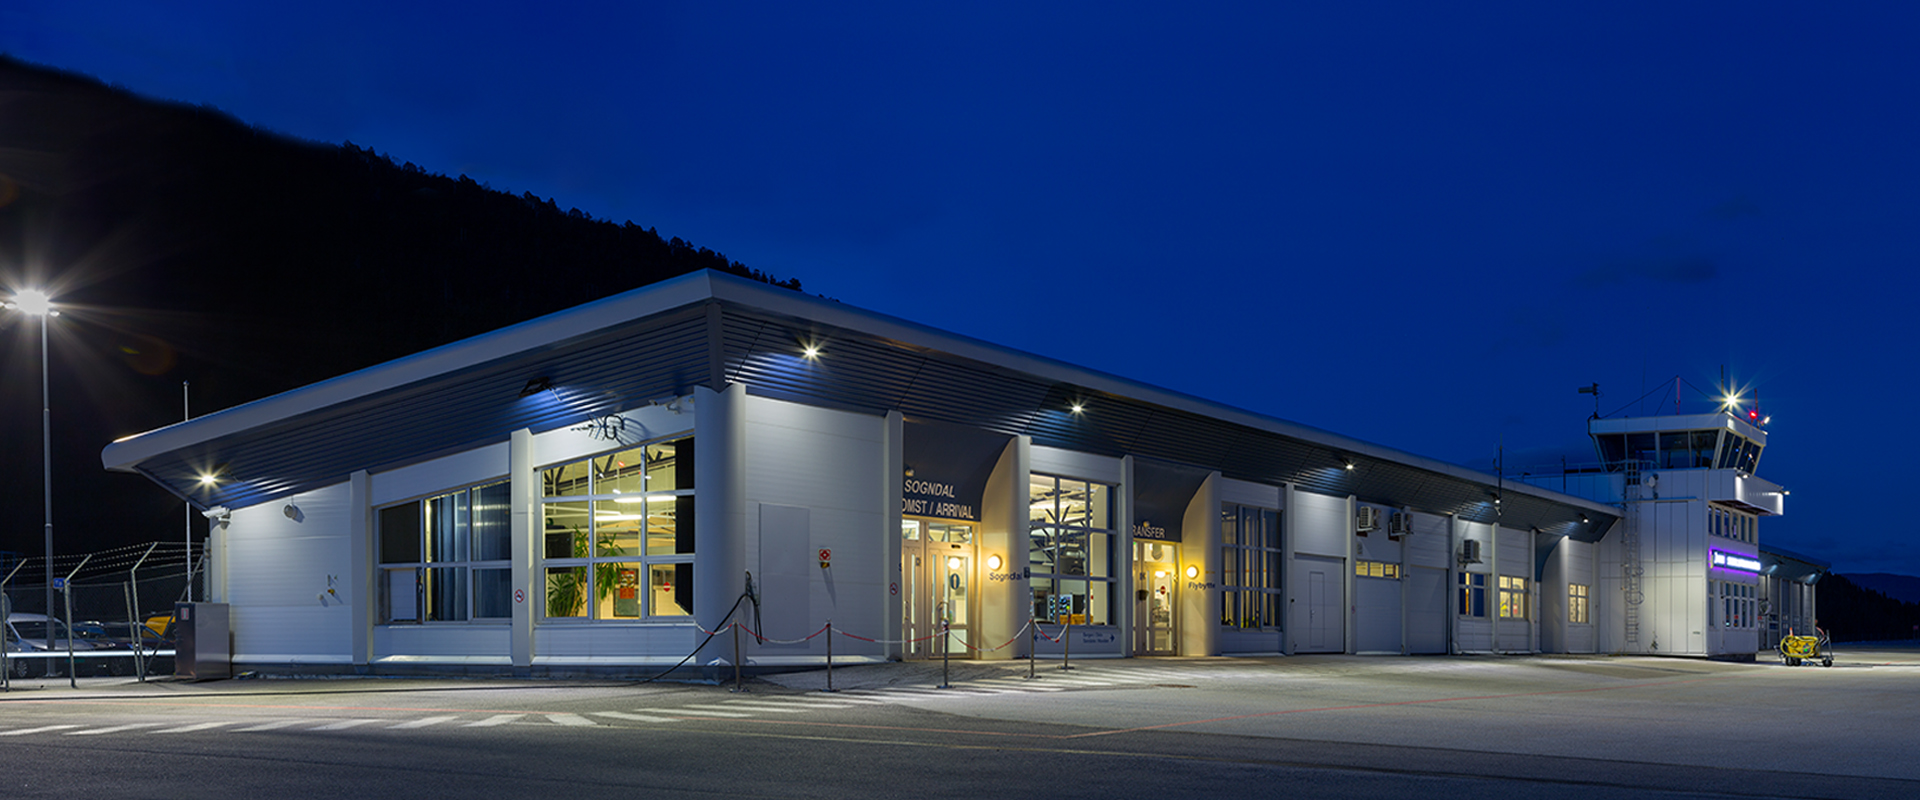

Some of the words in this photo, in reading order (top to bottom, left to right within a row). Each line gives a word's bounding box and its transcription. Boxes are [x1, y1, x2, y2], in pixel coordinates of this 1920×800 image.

[904, 479, 955, 498] SOGNDAL
[935, 502, 974, 519] ARRIVAL
[989, 571, 1023, 582] Sogndal
